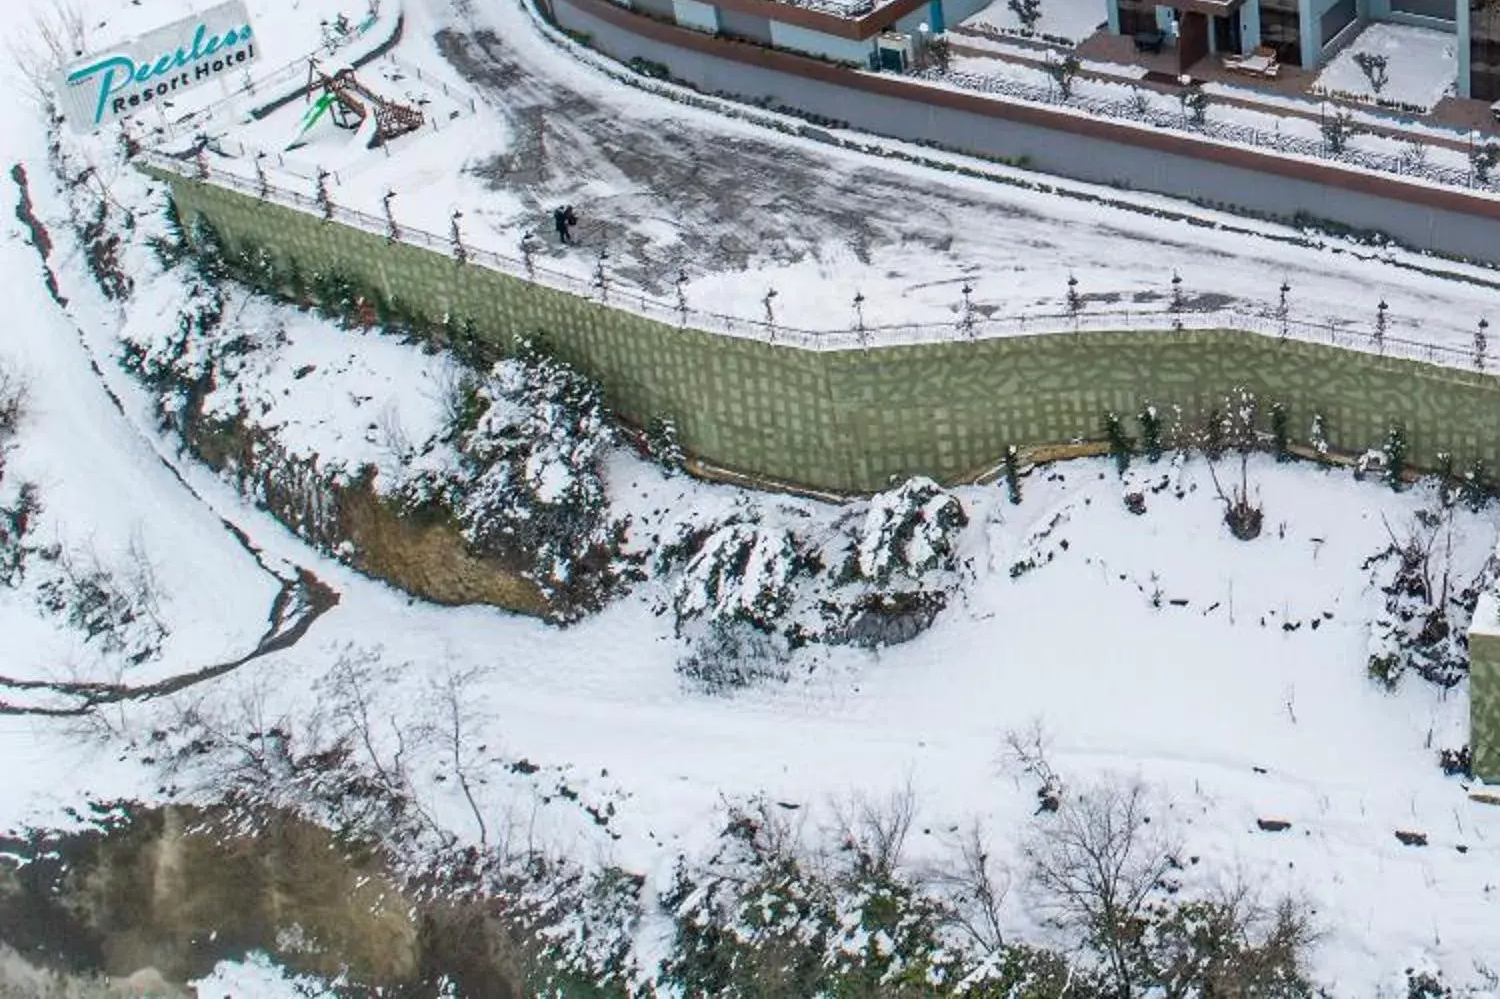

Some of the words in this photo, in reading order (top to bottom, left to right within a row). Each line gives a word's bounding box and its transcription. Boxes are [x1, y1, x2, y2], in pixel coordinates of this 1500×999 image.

[68, 24, 253, 123] Peerless
[113, 71, 189, 113] Resort
[195, 44, 254, 80] Hotel
